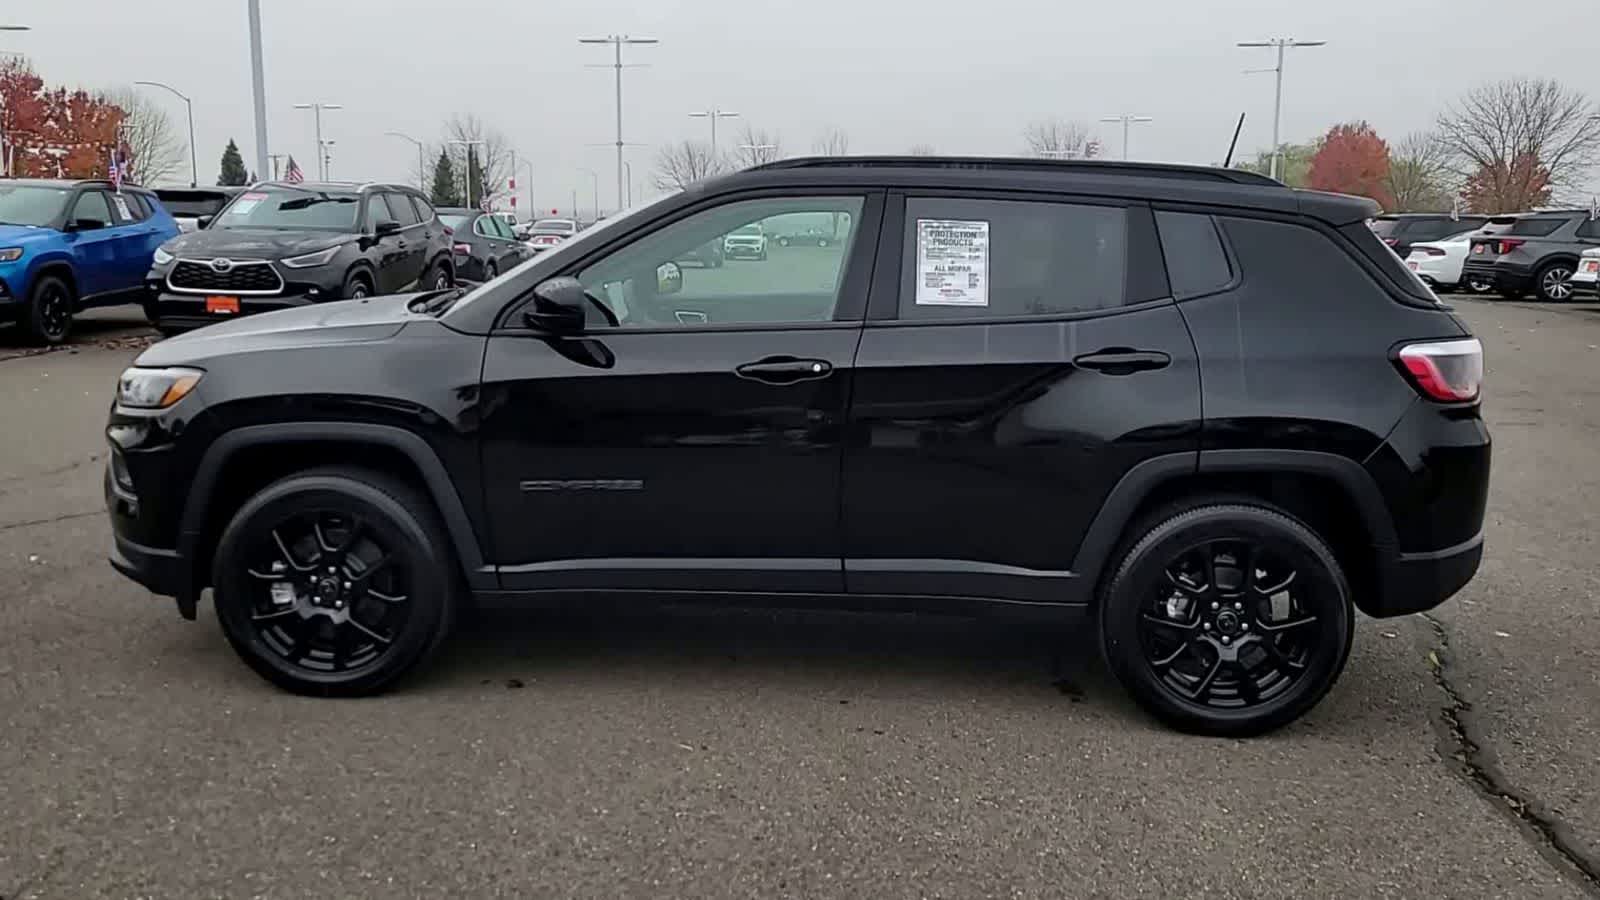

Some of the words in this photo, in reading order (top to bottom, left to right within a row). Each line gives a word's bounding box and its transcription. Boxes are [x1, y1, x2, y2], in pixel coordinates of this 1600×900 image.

[929, 230, 977, 239] PROTECTION
[932, 238, 974, 247] PRODUCTS
[947, 265, 972, 273] MOPAR
